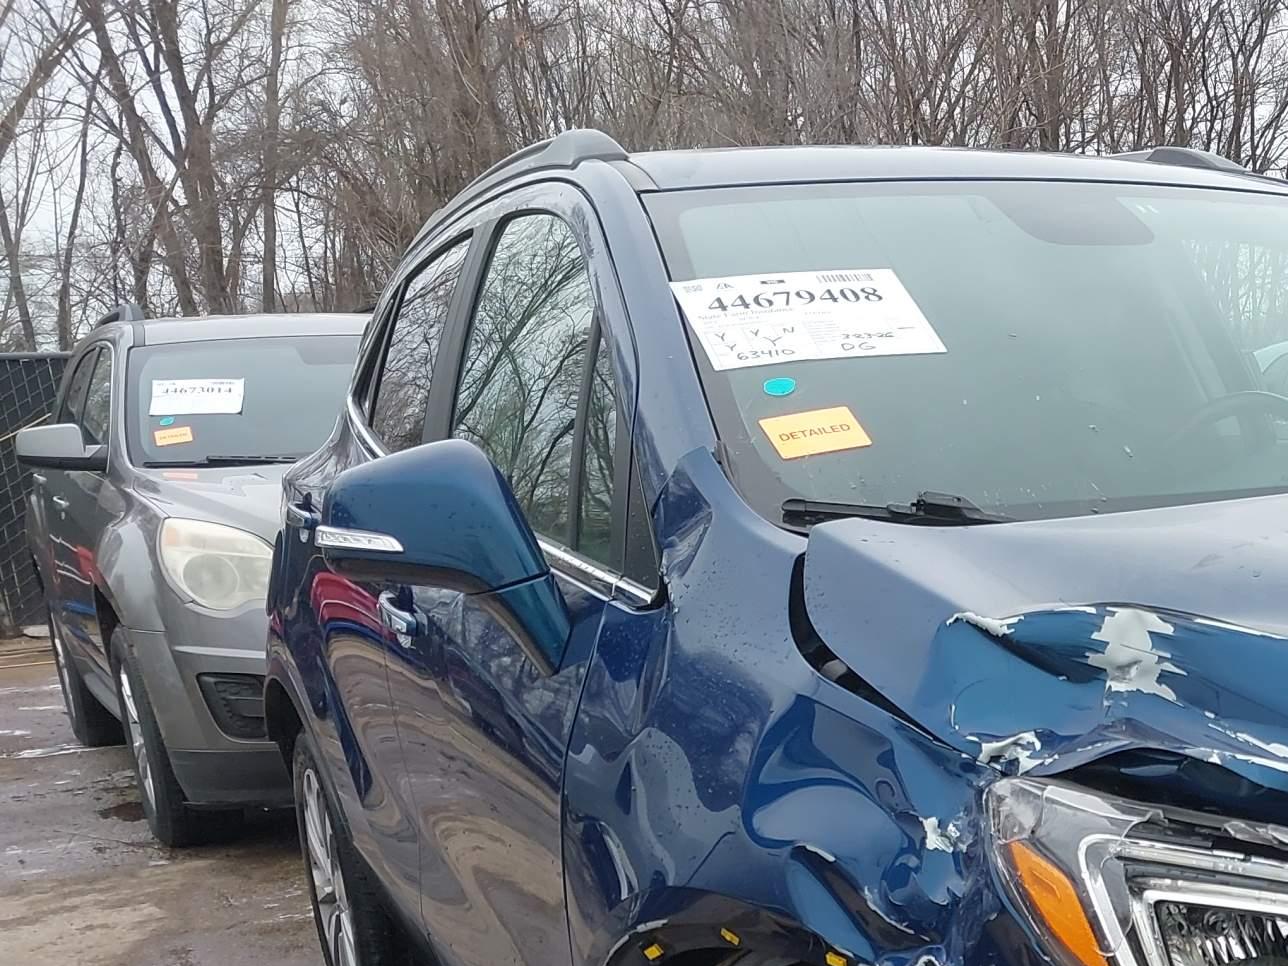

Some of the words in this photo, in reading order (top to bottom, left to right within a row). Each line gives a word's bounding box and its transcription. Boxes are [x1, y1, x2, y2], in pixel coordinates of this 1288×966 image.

[708, 287, 883, 312] 44679408
[736, 348, 796, 361] 63410
[778, 422, 851, 443] DETAILED
